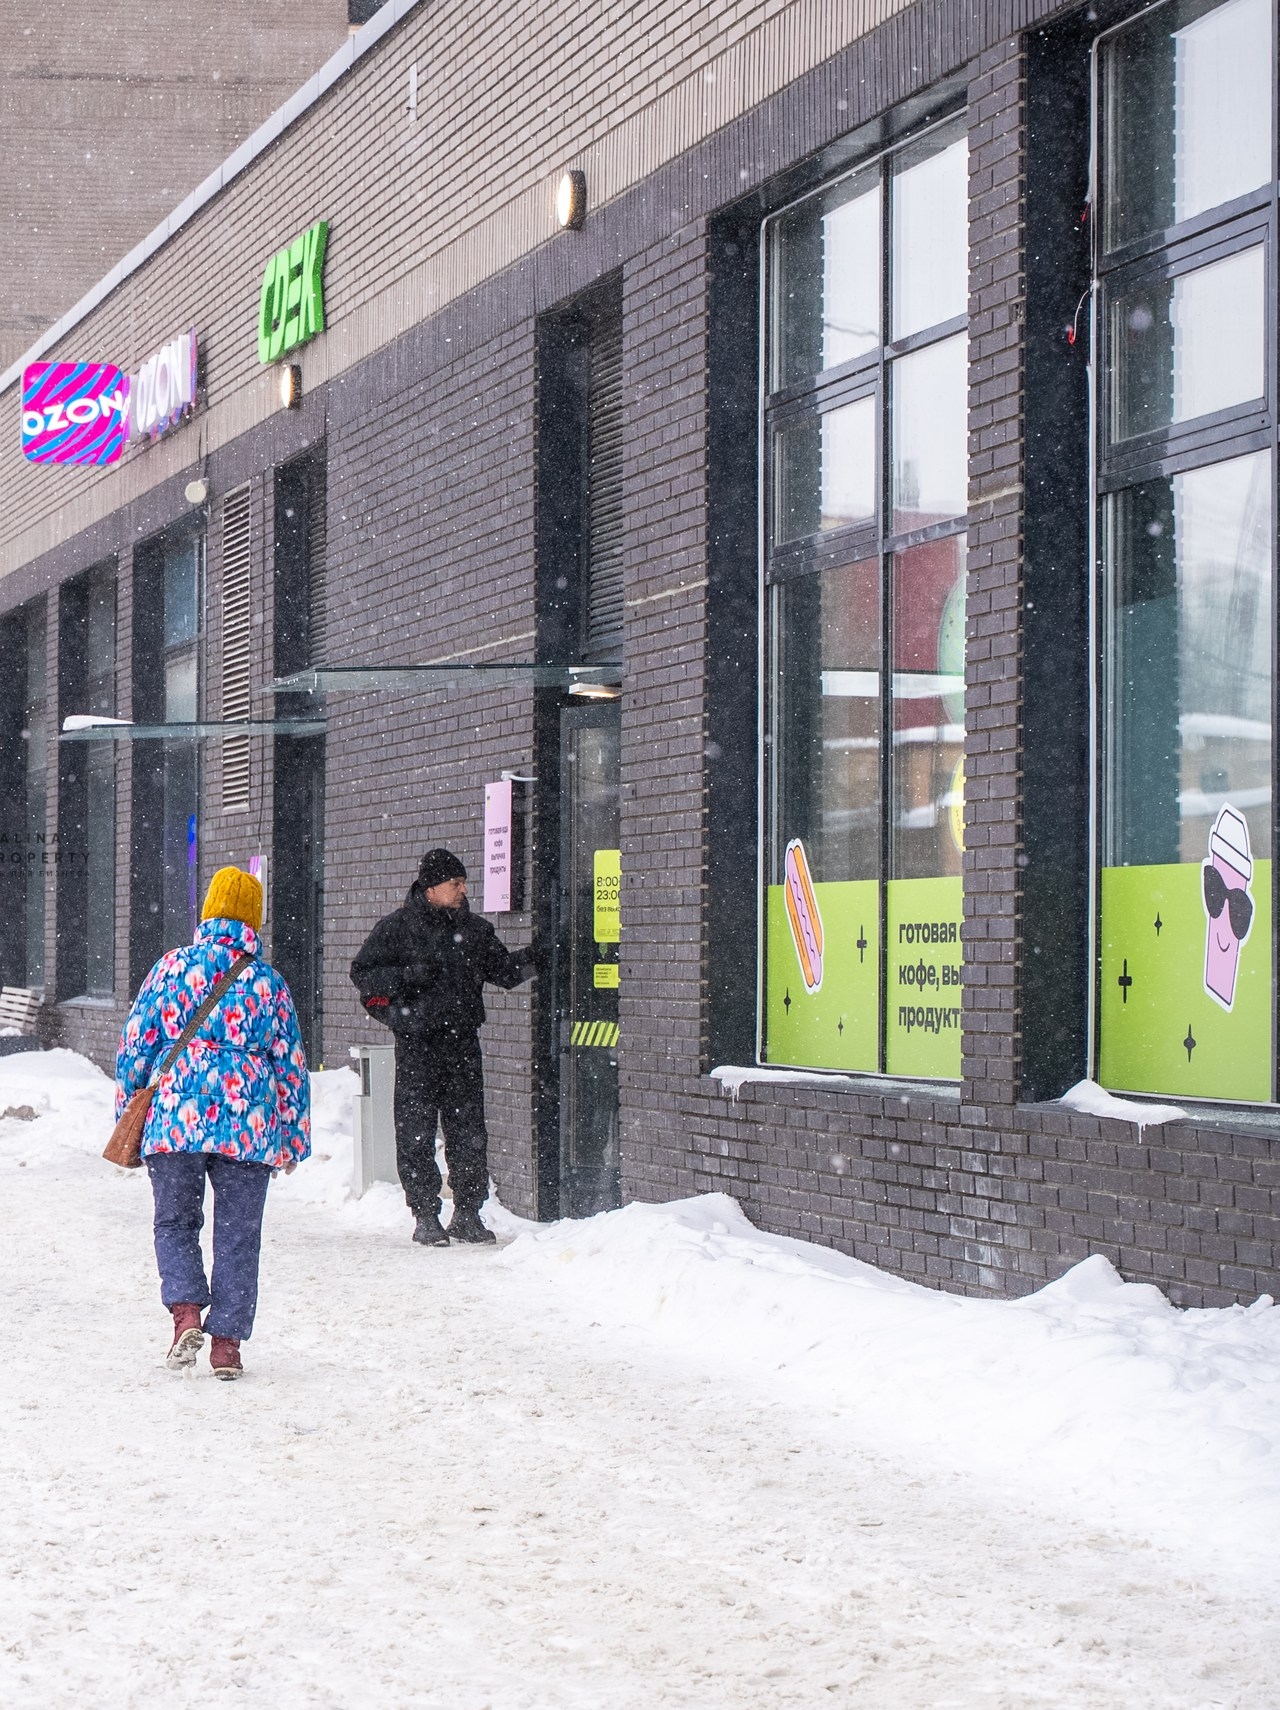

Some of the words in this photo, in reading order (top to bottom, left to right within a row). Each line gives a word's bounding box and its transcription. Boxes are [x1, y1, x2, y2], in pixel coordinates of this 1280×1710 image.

[258, 221, 329, 364] CDEK
[136, 335, 191, 432] OZON
[23, 390, 131, 436] OZON
[898, 922, 957, 944] готовая
[898, 958, 940, 992] кофе,
[898, 1006, 963, 1035] продукт
